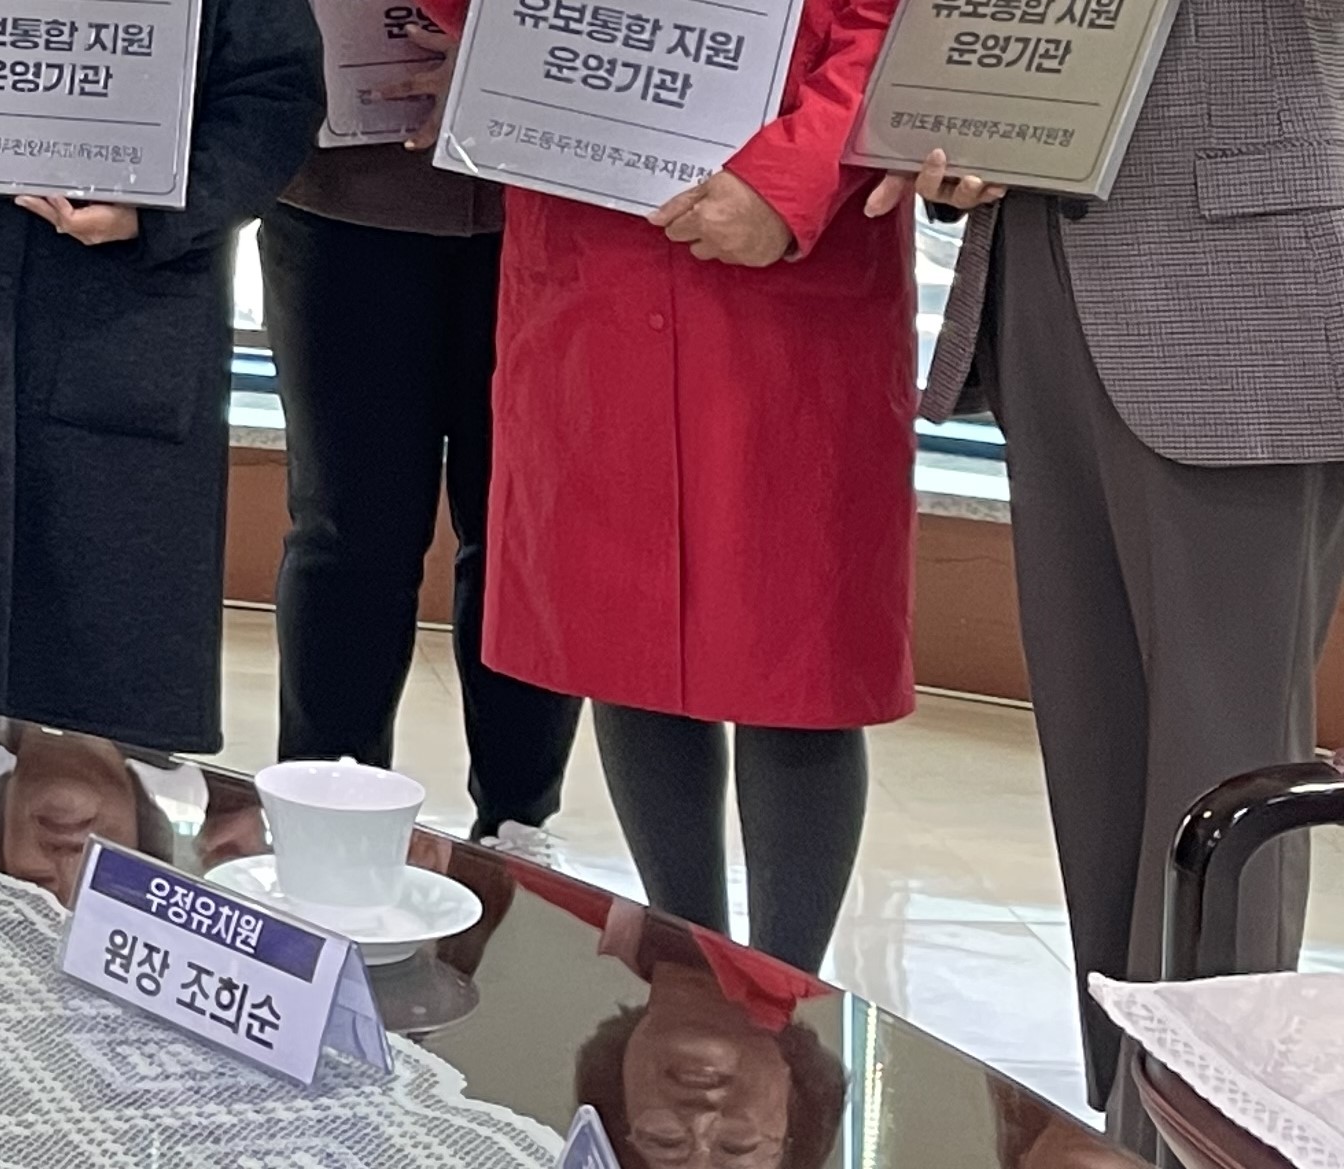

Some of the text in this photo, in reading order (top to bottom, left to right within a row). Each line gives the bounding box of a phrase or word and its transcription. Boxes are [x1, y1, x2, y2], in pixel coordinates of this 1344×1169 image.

[84, 22, 154, 57] 지원
[666, 23, 745, 72] 지원
[946, 32, 1072, 74] 운영기관
[543, 46, 693, 109] 운영기관
[890, 111, 1075, 147] 경기도동두천양주교육지원청
[146, 877, 264, 954] 우정유치원
[104, 929, 282, 1050] 원장 조희순
